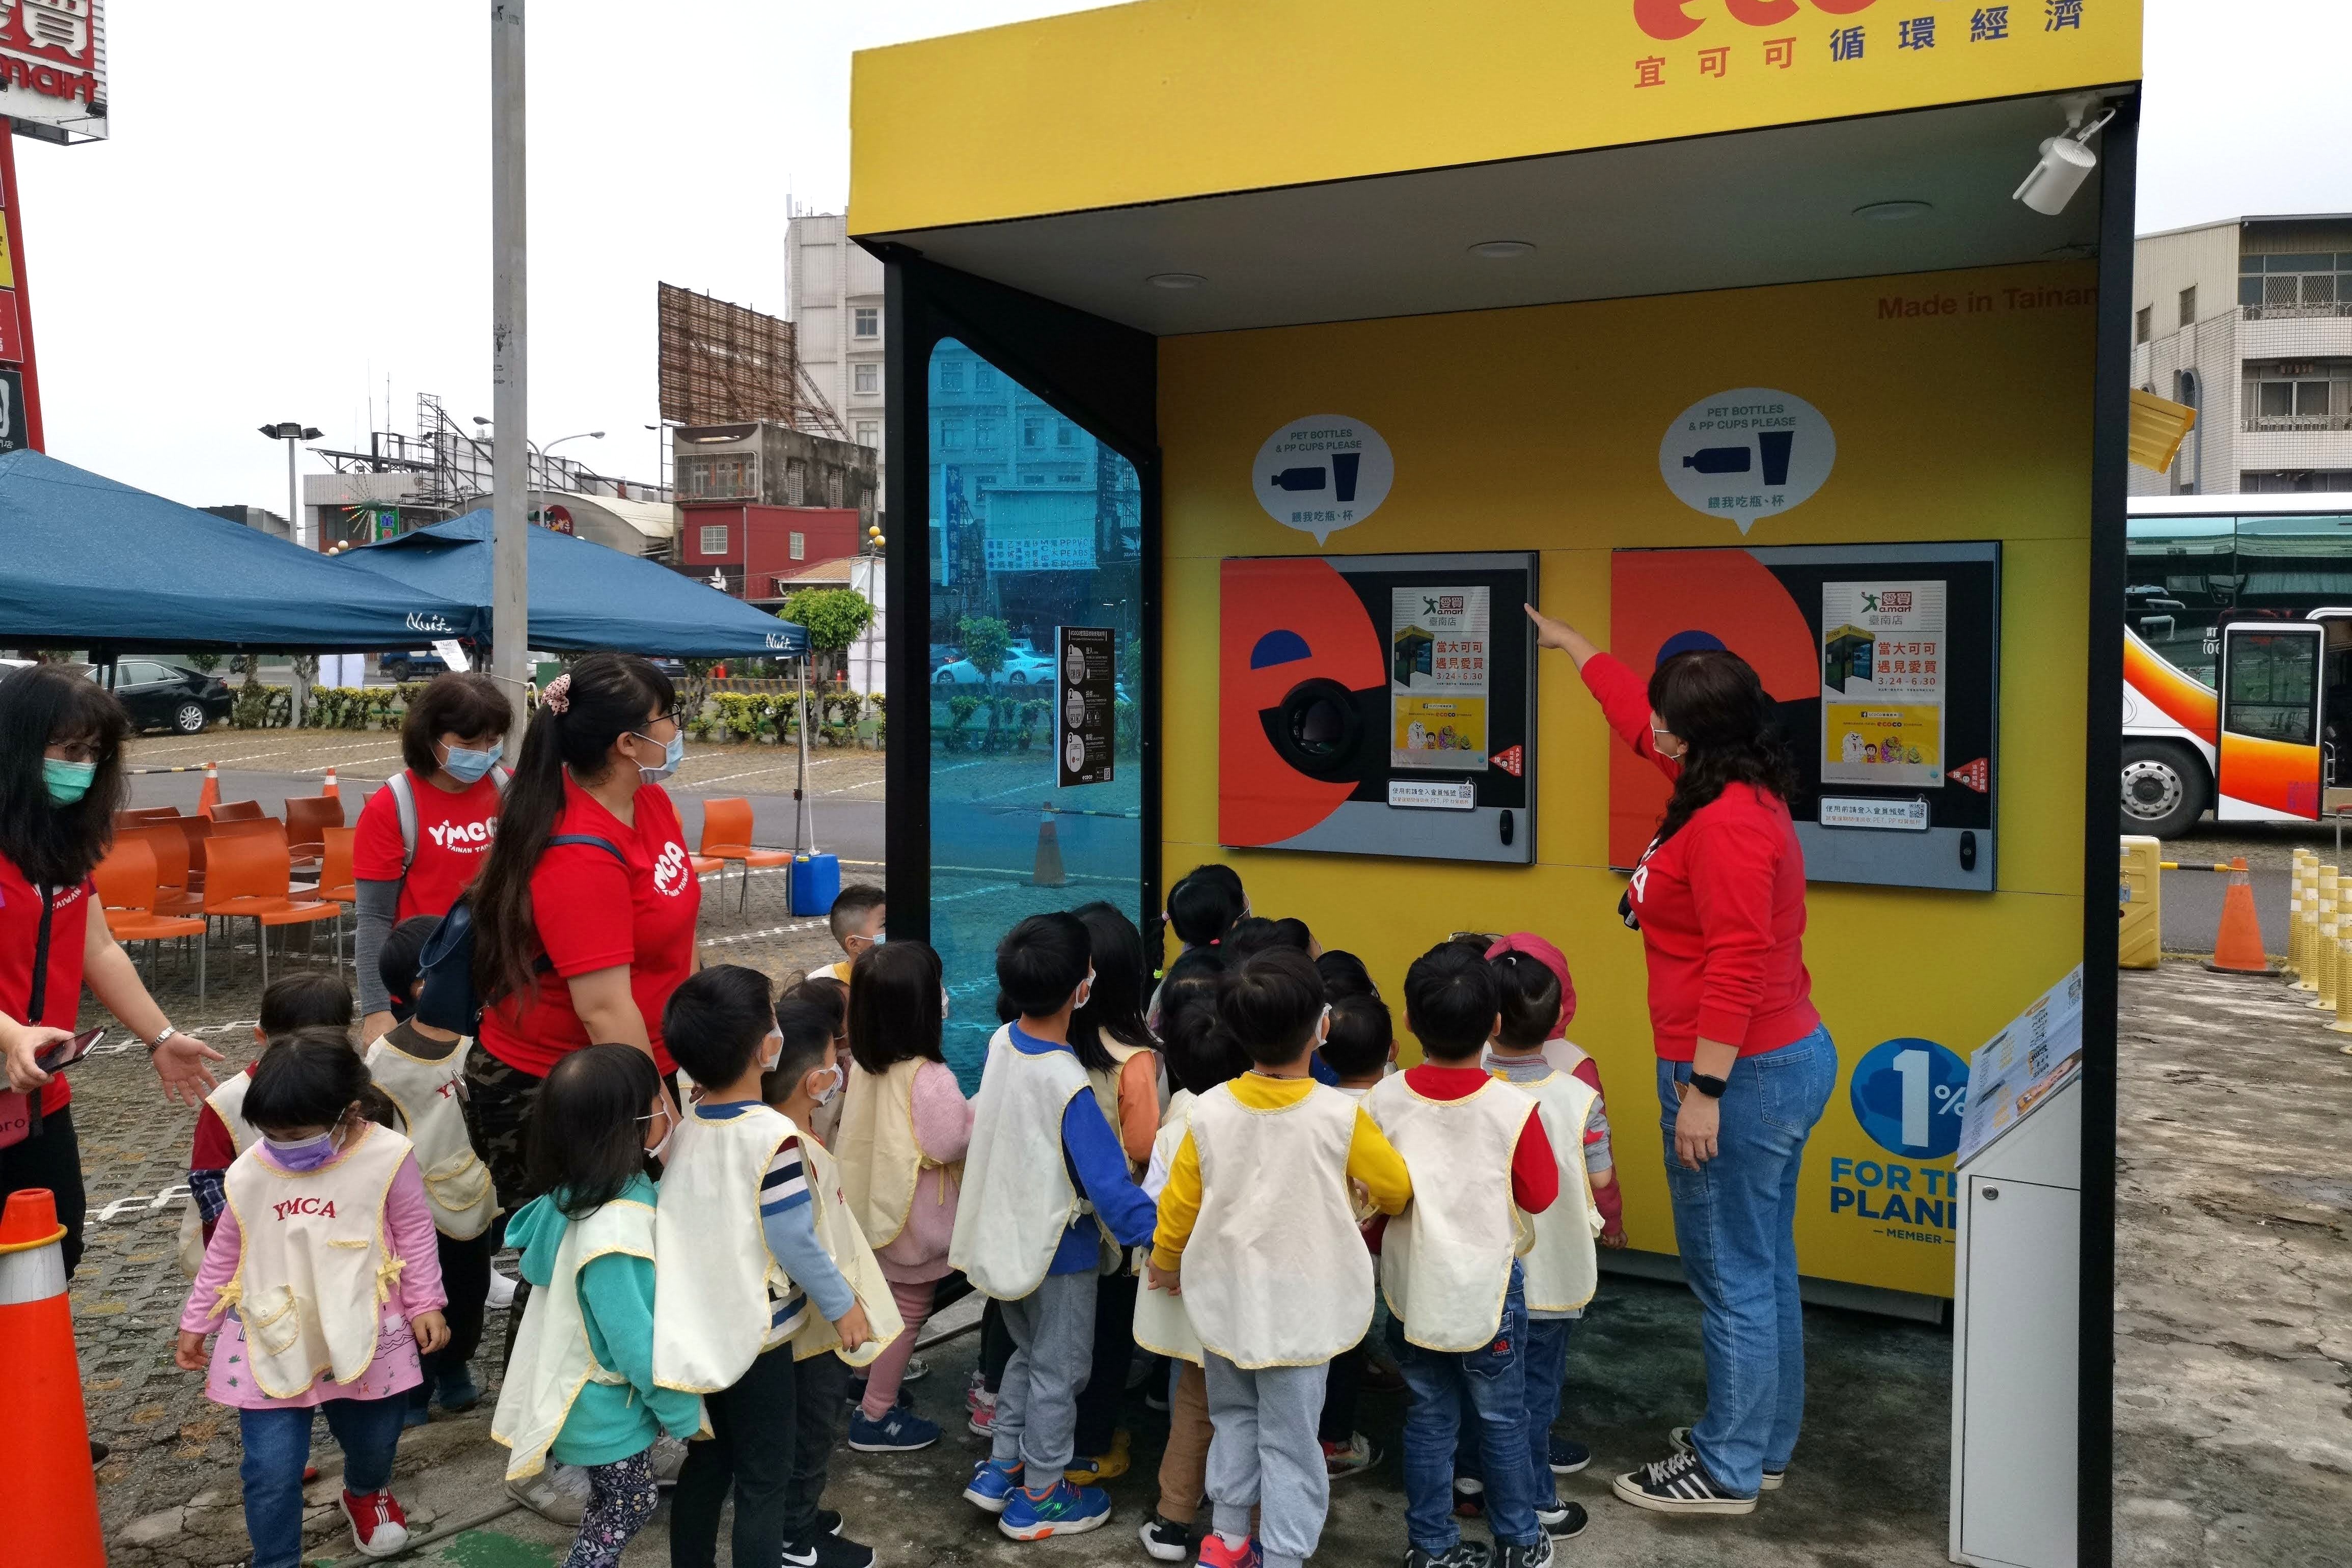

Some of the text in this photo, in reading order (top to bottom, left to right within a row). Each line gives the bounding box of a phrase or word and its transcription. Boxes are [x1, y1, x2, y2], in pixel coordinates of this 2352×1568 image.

[0, 0, 88, 60] 買
[1634, 0, 2084, 89] 宜可可循環經濟
[1878, 286, 2098, 319] Made in Tainan
[1707, 404, 1784, 417] PET BOTTLES
[1689, 417, 1796, 431] & PP CUPS PLEASE
[1310, 429, 1353, 439] BOTTLES
[1284, 444, 1296, 452] PP
[1299, 442, 1324, 451] CUPS
[1326, 441, 1362, 450] PLEASE
[1708, 494, 1785, 509] 餵我吃瓶、杯
[1440, 597, 1463, 608] 愛買
[1882, 592, 1911, 605] 愛買
[406, 612, 452, 631] Nuit
[1429, 617, 1457, 626] 臺南店
[1869, 615, 1903, 625] 臺南店
[1070, 645, 1073, 654] 1
[1436, 641, 1483, 653] 當大可可
[1878, 642, 1936, 655] 當大可可
[1436, 657, 1483, 670] 遇見愛買
[1877, 660, 1936, 673] 遇見愛買
[1069, 689, 1073, 699] 2
[1069, 733, 1073, 743] 3
[447, 843, 472, 854] TAINAN
[52, 888, 81, 911] AIWAN
[1830, 1157, 1911, 1192] FOR
[273, 1197, 336, 1221] YMCA
[1886, 1228, 1943, 1244] MEMBER
